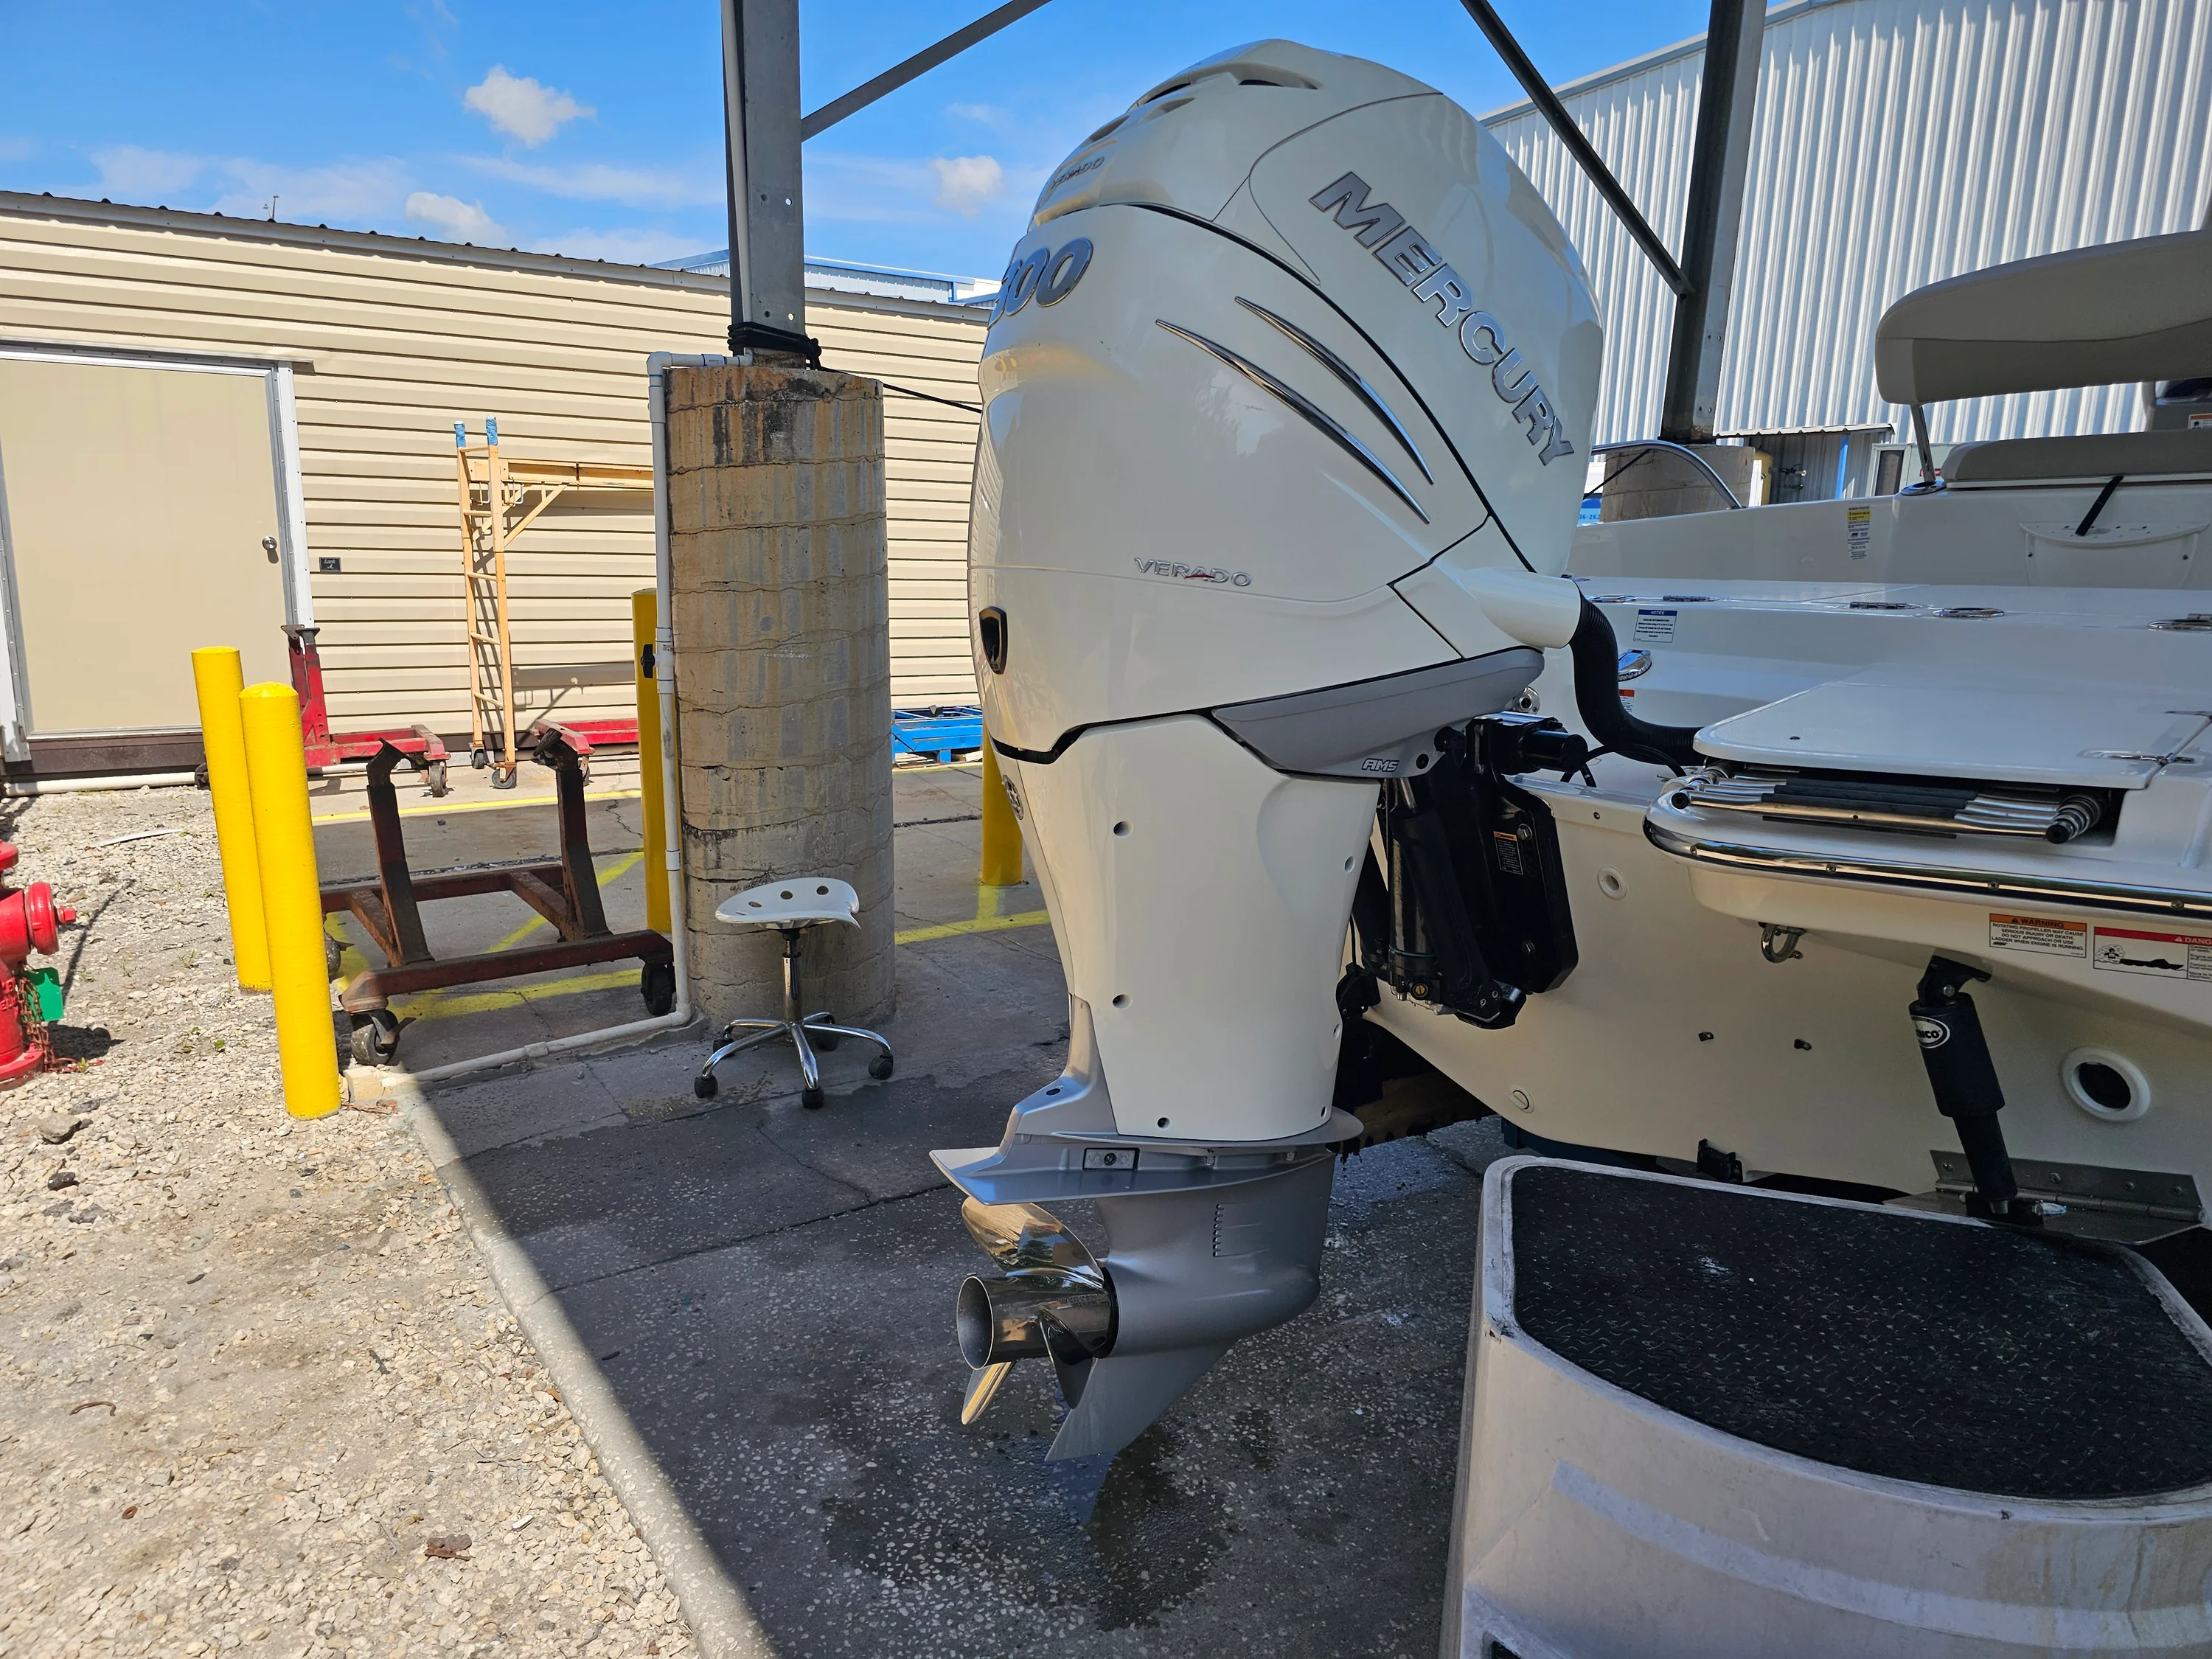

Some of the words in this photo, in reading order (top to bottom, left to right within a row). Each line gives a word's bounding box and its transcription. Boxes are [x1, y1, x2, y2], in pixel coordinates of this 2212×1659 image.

[1309, 171, 1574, 466] MERCURY
[1133, 557, 1253, 587] VERADO
[1362, 758, 1399, 773] AMS
[2020, 917, 2065, 928] WARNING
